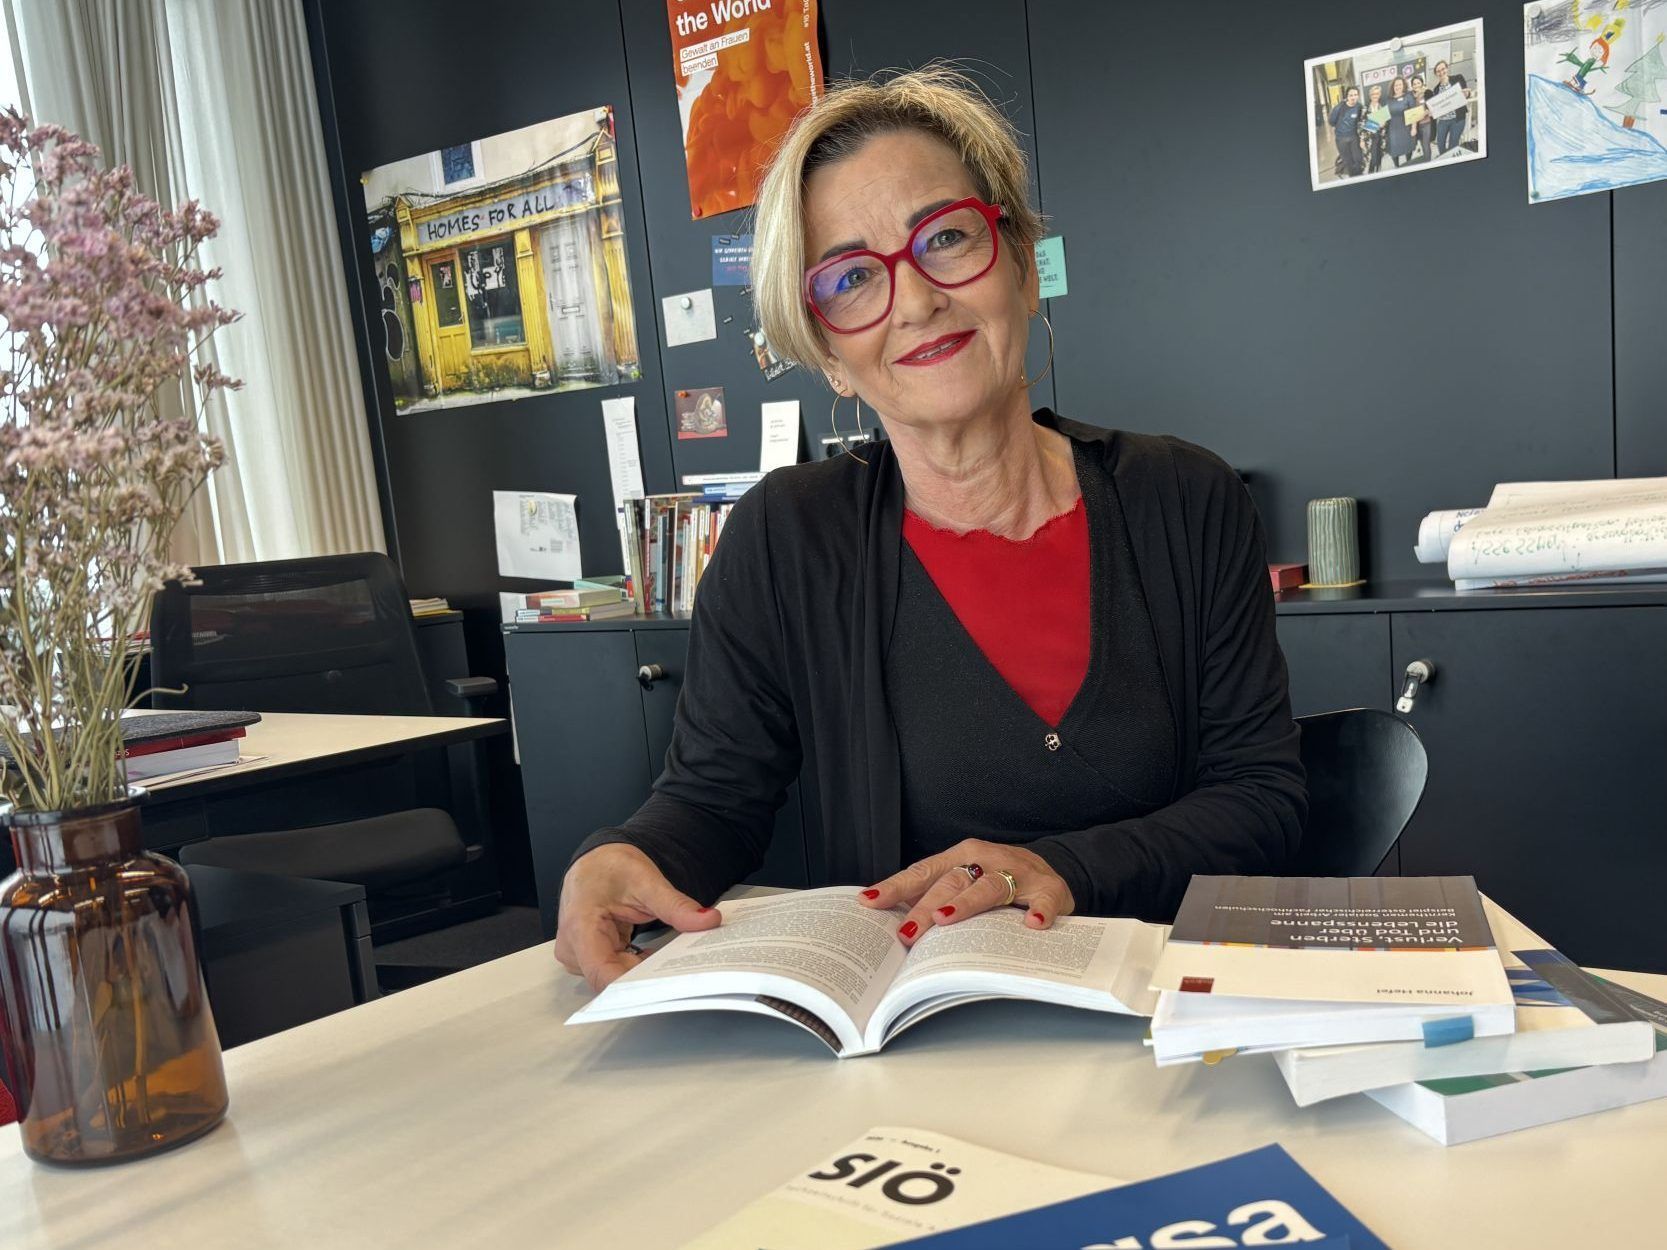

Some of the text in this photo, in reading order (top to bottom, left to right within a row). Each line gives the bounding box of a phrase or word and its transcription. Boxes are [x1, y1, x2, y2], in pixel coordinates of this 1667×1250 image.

[676, 0, 772, 36] the World
[681, 32, 748, 59] Gewalt an Frauen
[682, 56, 717, 74] beenden
[427, 195, 555, 241] HOMES FOR ALL
[1270, 919, 1458, 928] die Lebensspanne
[1319, 928, 1368, 936] über
[1375, 928, 1413, 936] Tod
[1290, 935, 1373, 943] Sterben
[808, 1153, 961, 1206] SIÖ
[1080, 1199, 1326, 1250] sa
